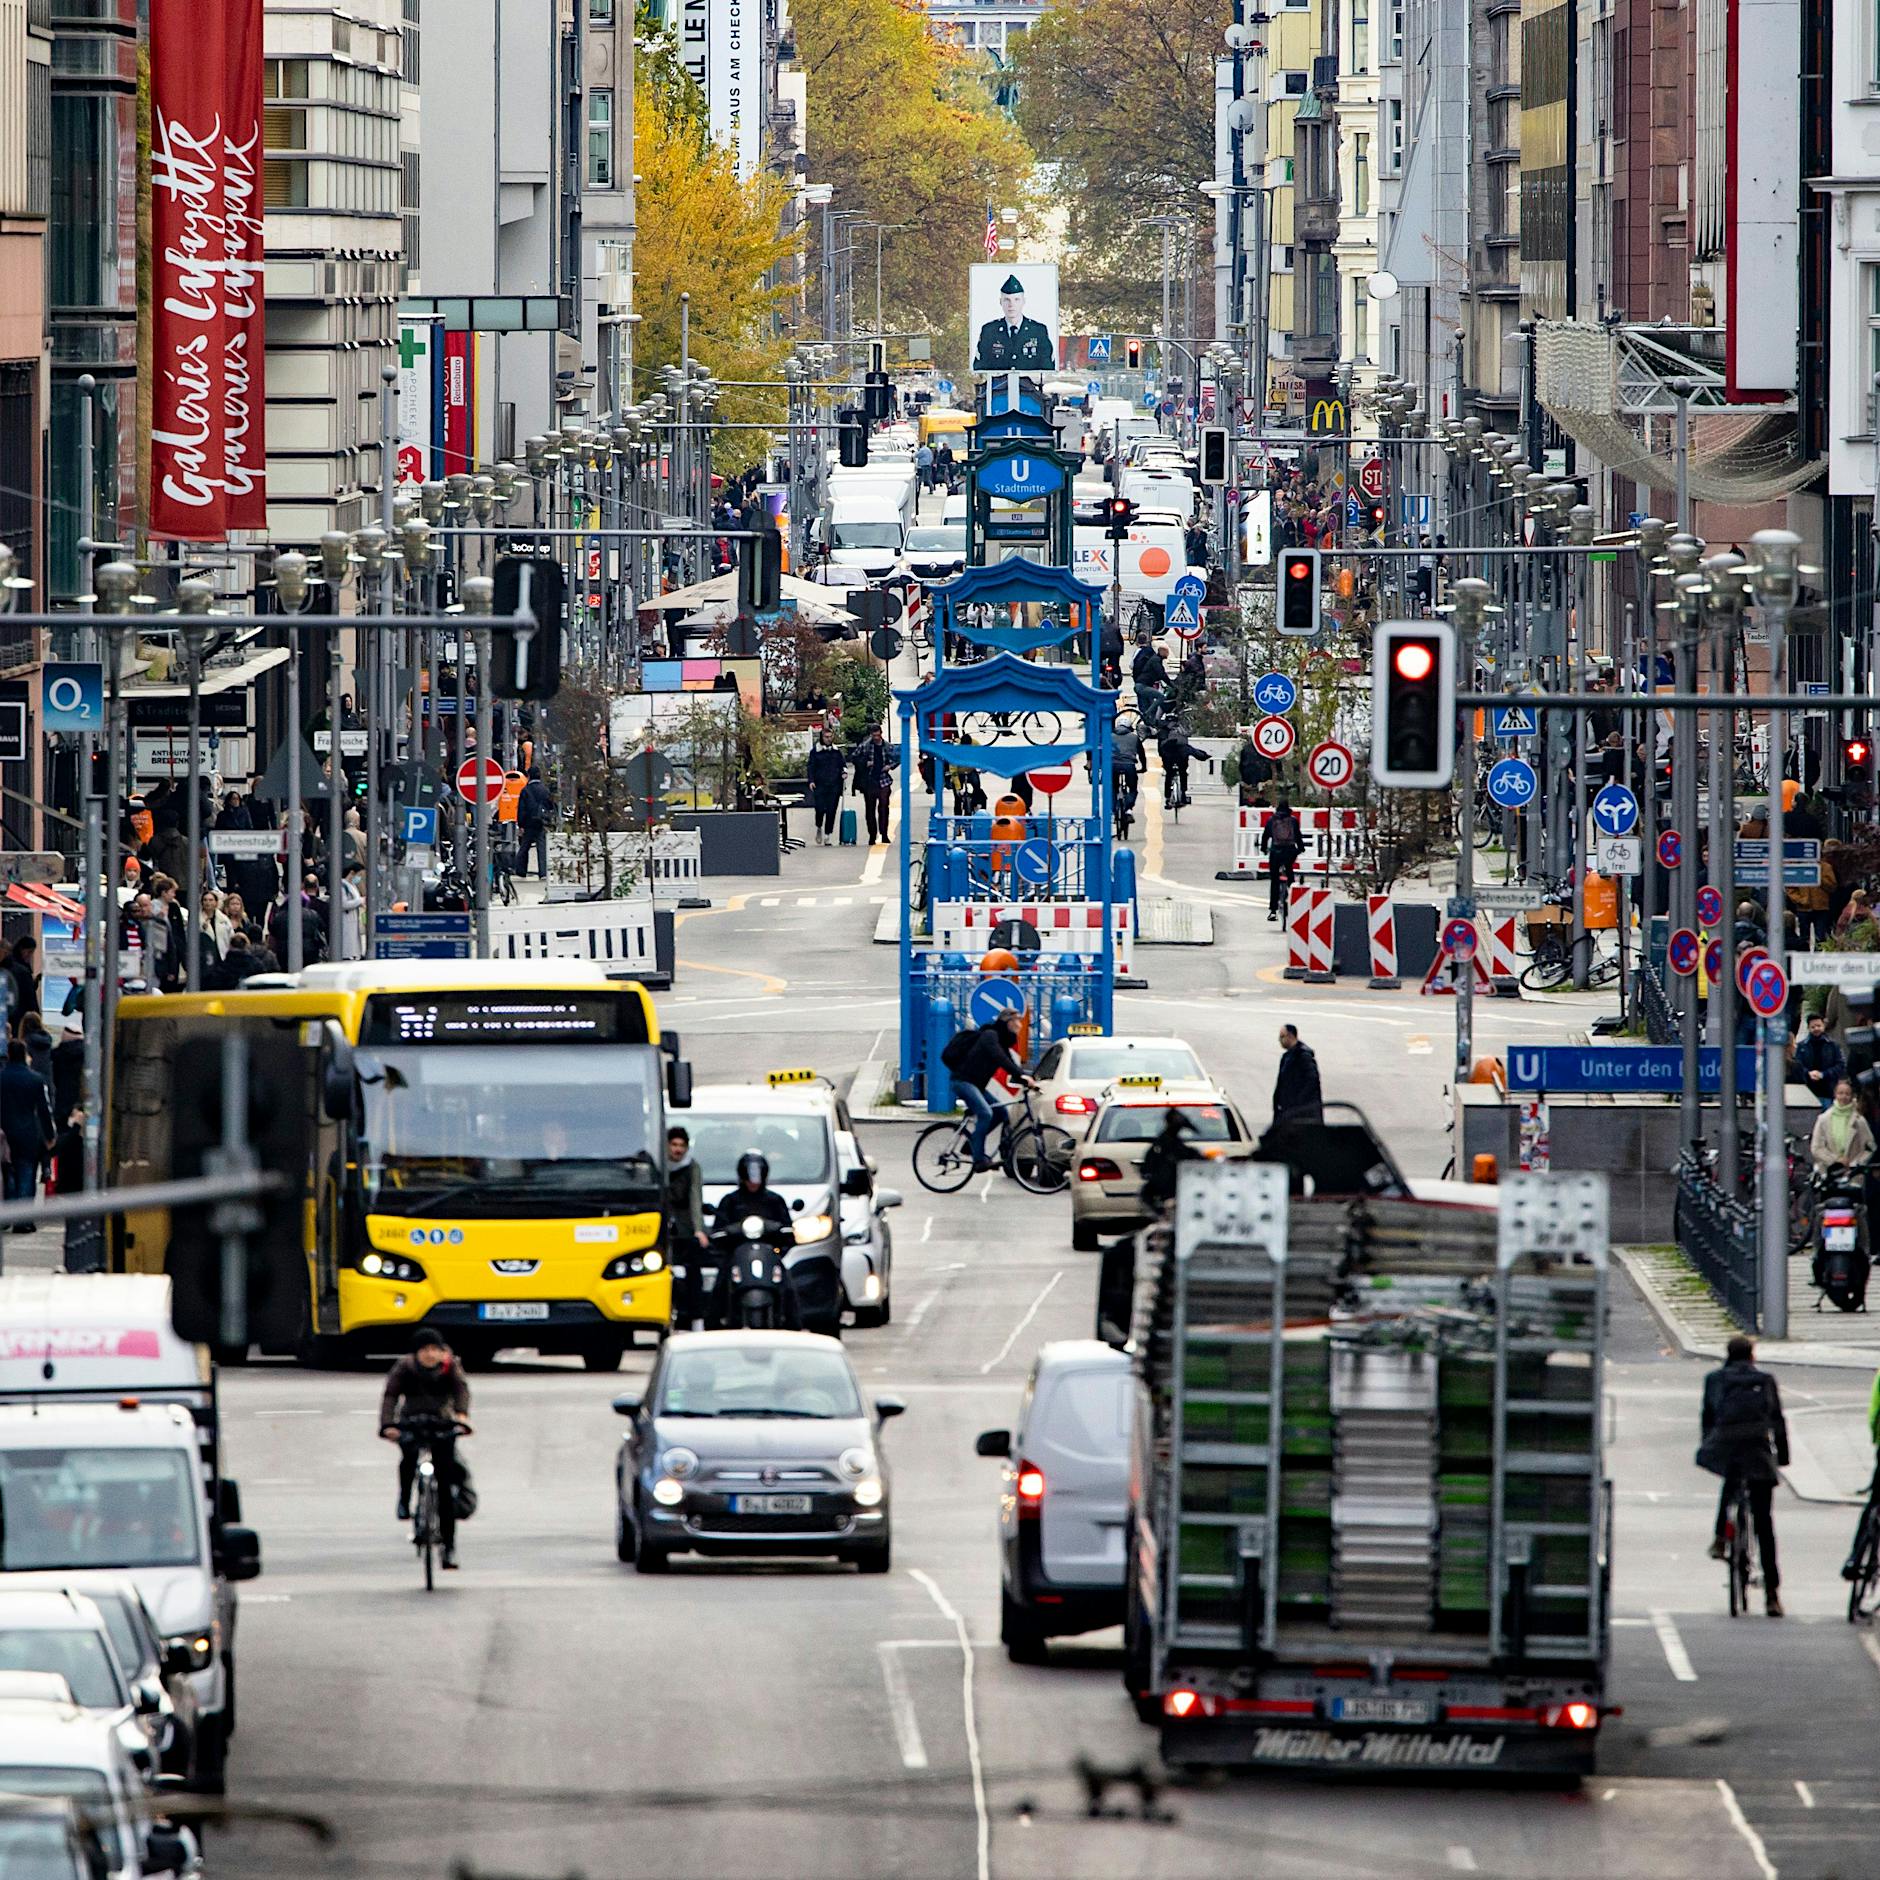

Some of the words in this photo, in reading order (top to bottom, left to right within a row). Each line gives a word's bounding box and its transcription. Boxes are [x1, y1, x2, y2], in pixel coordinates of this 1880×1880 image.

[729, 57, 741, 81] AM
[152, 104, 226, 322] Lafayette
[409, 370, 418, 427] APOTHEKE
[152, 334, 225, 507] Galeries
[1011, 459, 1030, 482] U
[994, 483, 1047, 494] Stadtmitte
[1264, 729, 1285, 745] 20
[1318, 756, 1342, 776] 20
[407, 812, 428, 839] P
[1516, 1053, 1540, 1082] U
[1581, 1059, 1632, 1077] Unter
[1638, 1059, 1672, 1077] den
